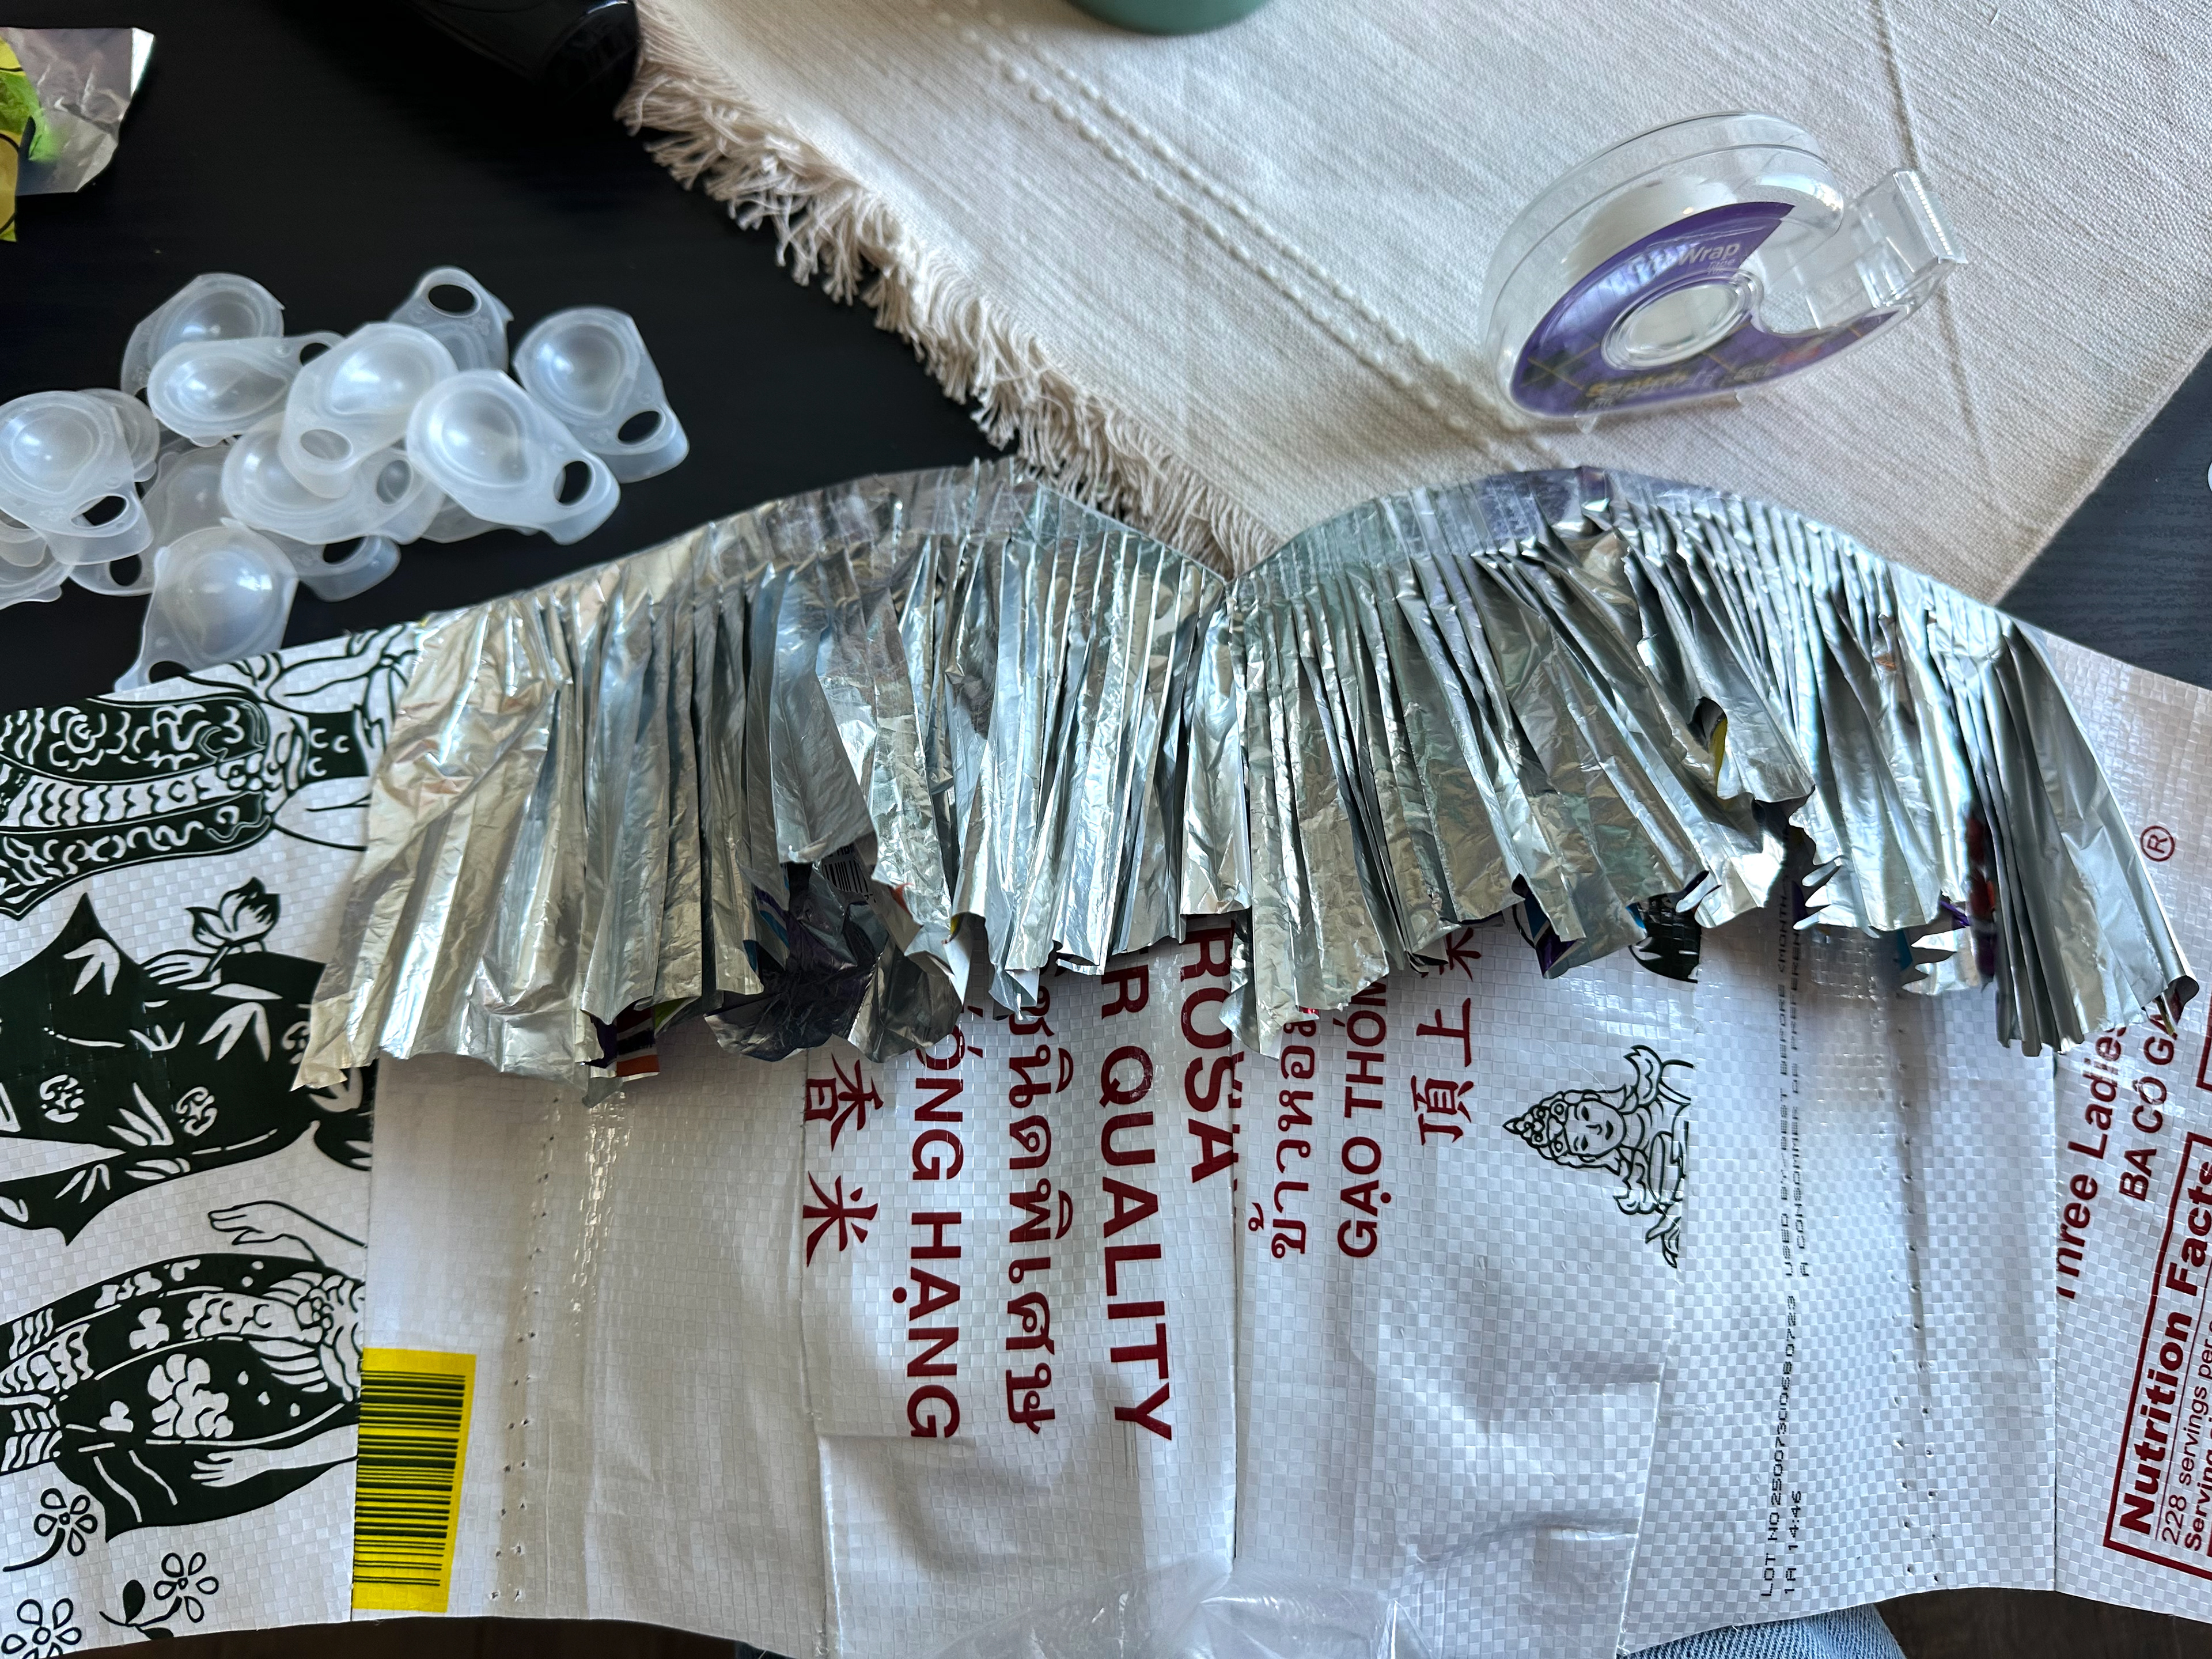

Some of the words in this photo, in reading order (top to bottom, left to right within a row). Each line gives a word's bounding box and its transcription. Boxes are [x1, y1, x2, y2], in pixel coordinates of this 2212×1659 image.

[1677, 243, 1740, 266] Wrap
[1778, 984, 1787, 1075] BEFORE
[1789, 929, 1800, 1050] PREFEREN
[1179, 917, 1234, 1184] ROSA
[1336, 1136, 1392, 1258] GẠO
[2119, 1147, 2157, 1202] BA
[1099, 1044, 1172, 1440] QUALITY
[1781, 1213, 1793, 1276] USED
[2119, 1311, 2192, 1536] Nutrition
[2165, 1160, 2212, 1297] Facts
[2161, 1494, 2187, 1546] 228
[2179, 1385, 2209, 1486] servings
[1787, 1490, 1801, 1550] 14:46
[1760, 1552, 1776, 1596] LOT
